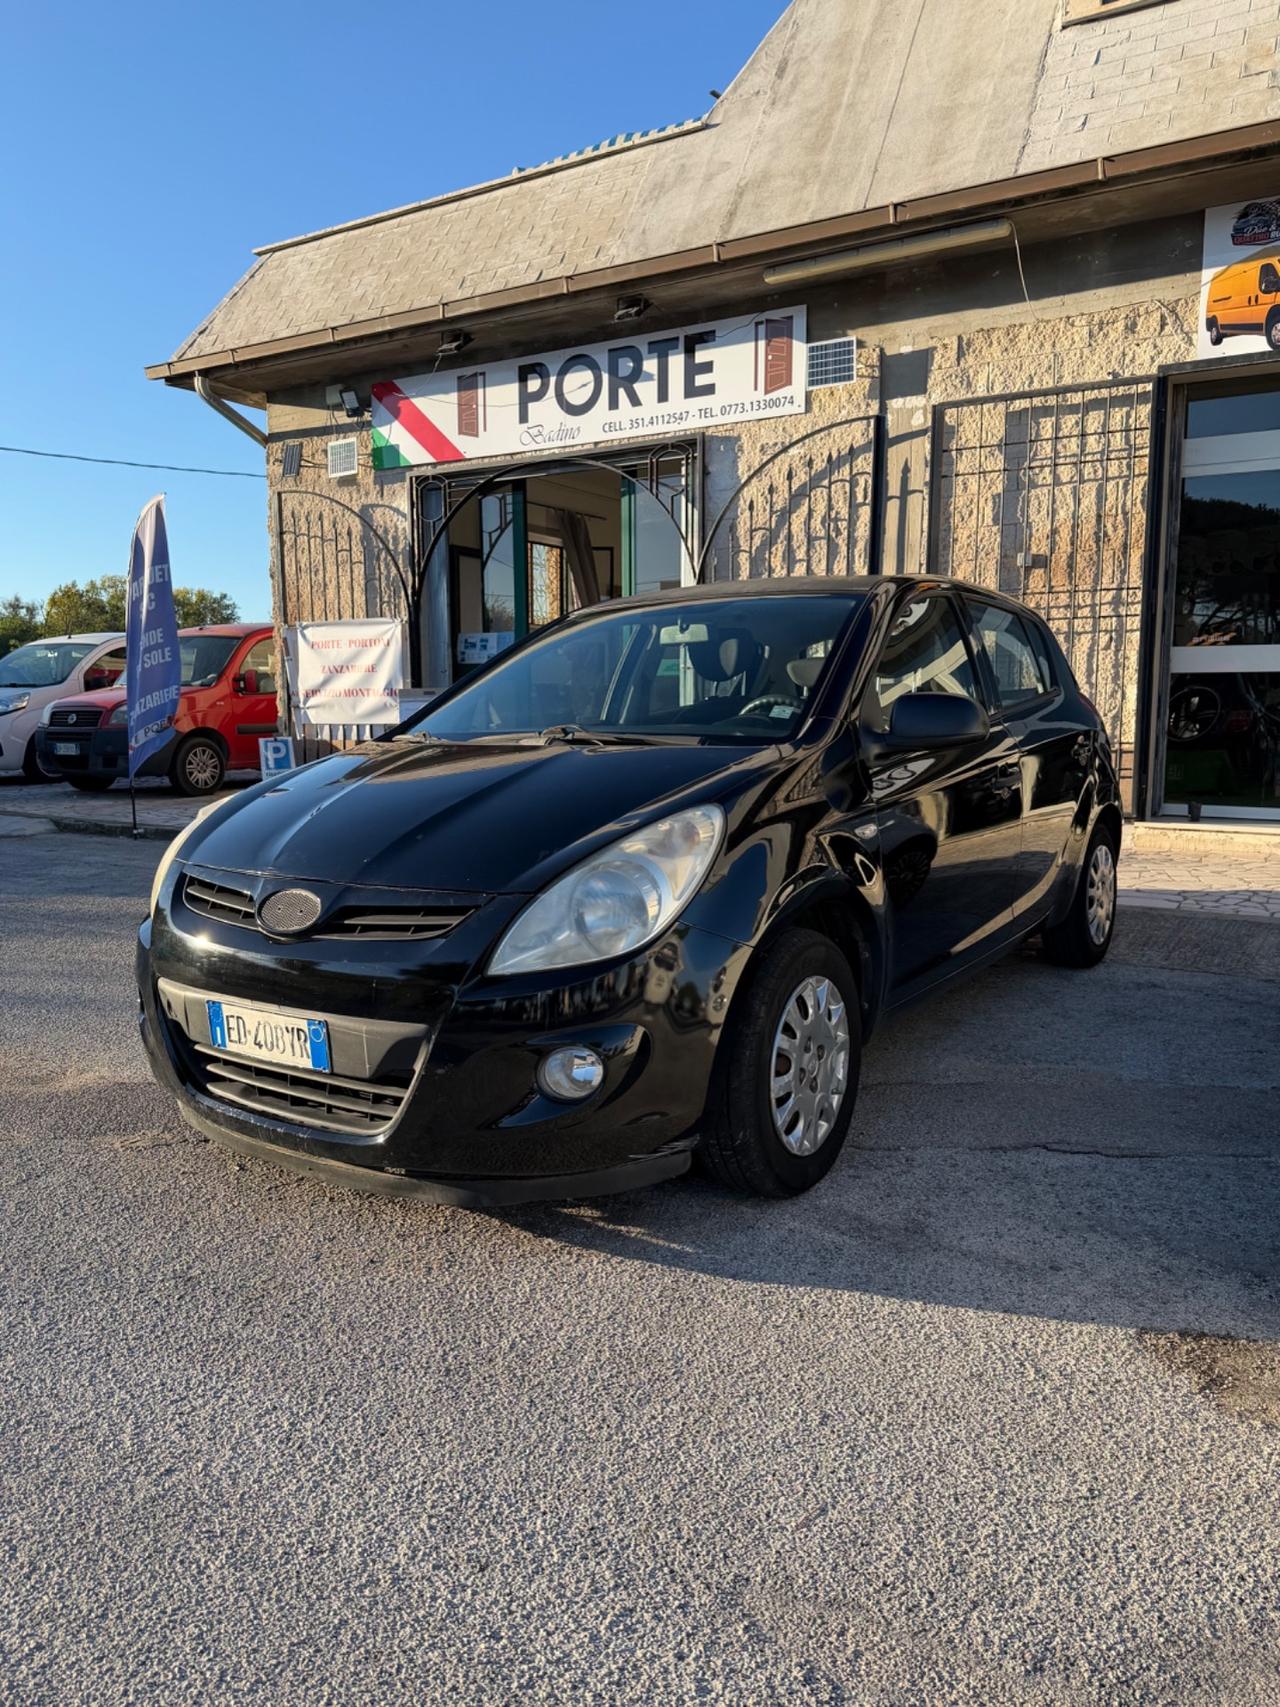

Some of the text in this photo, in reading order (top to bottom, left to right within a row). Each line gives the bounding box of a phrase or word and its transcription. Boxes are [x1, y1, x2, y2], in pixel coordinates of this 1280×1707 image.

[518, 330, 716, 424] PORTE
[602, 418, 627, 434] CELL.
[629, 410, 690, 430] 351.4112547
[697, 405, 719, 421] TEL.
[720, 395, 795, 417] 0773.1330074
[519, 424, 581, 447] Badino
[143, 647, 172, 668] SOLE
[311, 640, 342, 649] PORTE
[267, 742, 286, 768] P
[225, 1014, 248, 1046] ED
